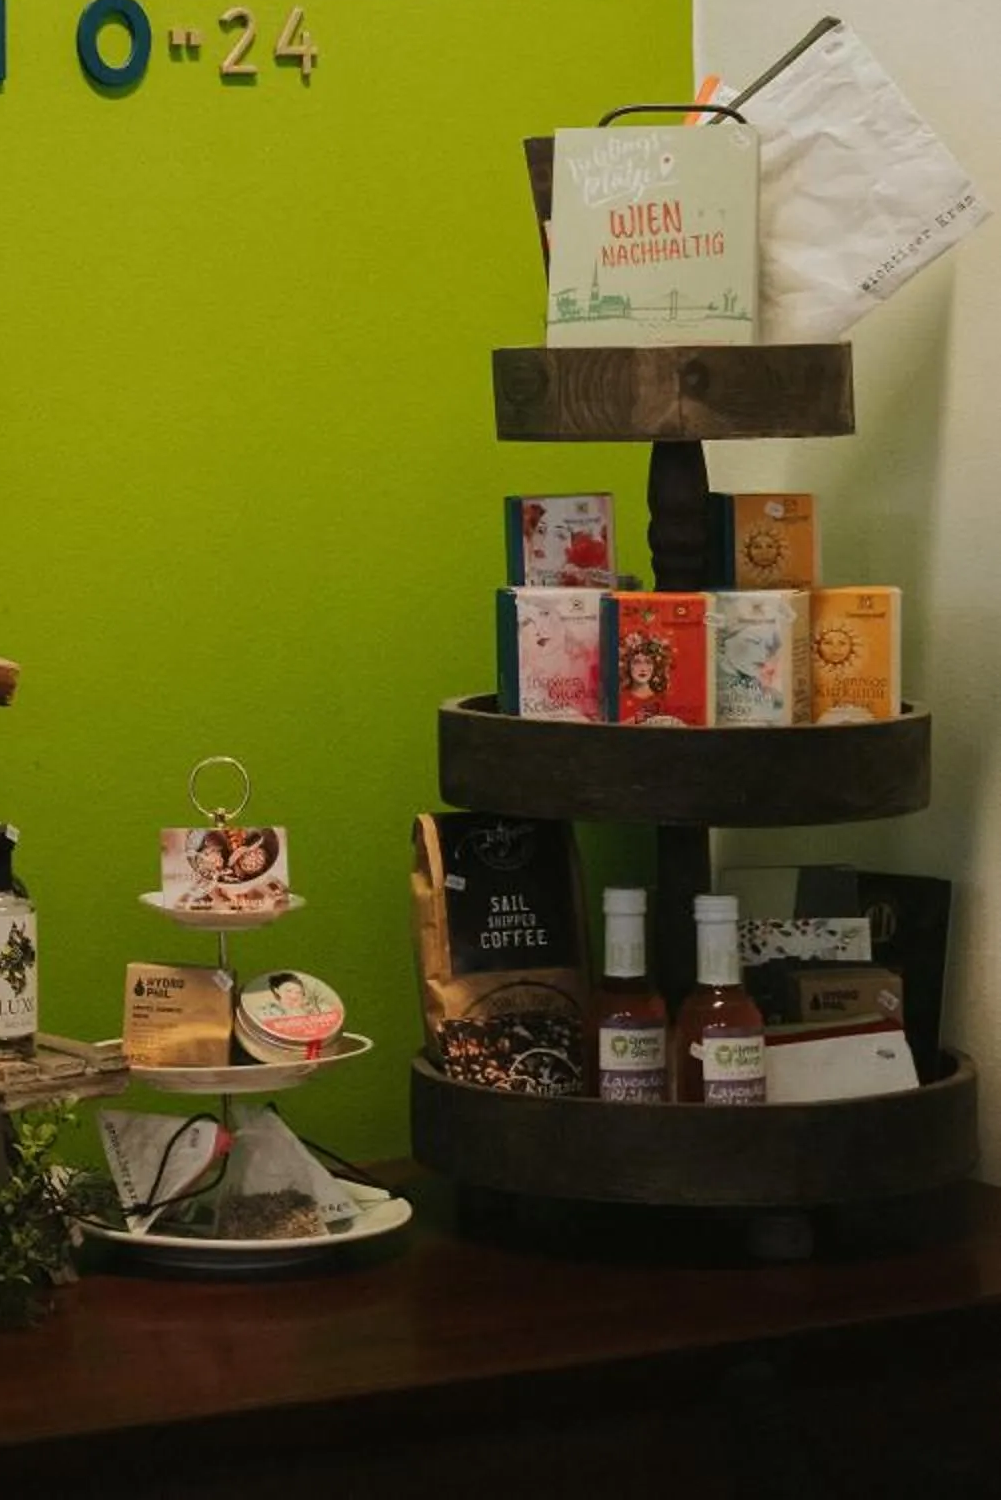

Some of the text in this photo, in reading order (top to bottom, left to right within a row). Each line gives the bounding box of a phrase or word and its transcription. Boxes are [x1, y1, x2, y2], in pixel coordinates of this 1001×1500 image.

[609, 201, 683, 239] WIEN
[601, 233, 725, 268] NACHHALTIG
[488, 894, 532, 913] SAIL
[479, 929, 550, 950] COFFEE
